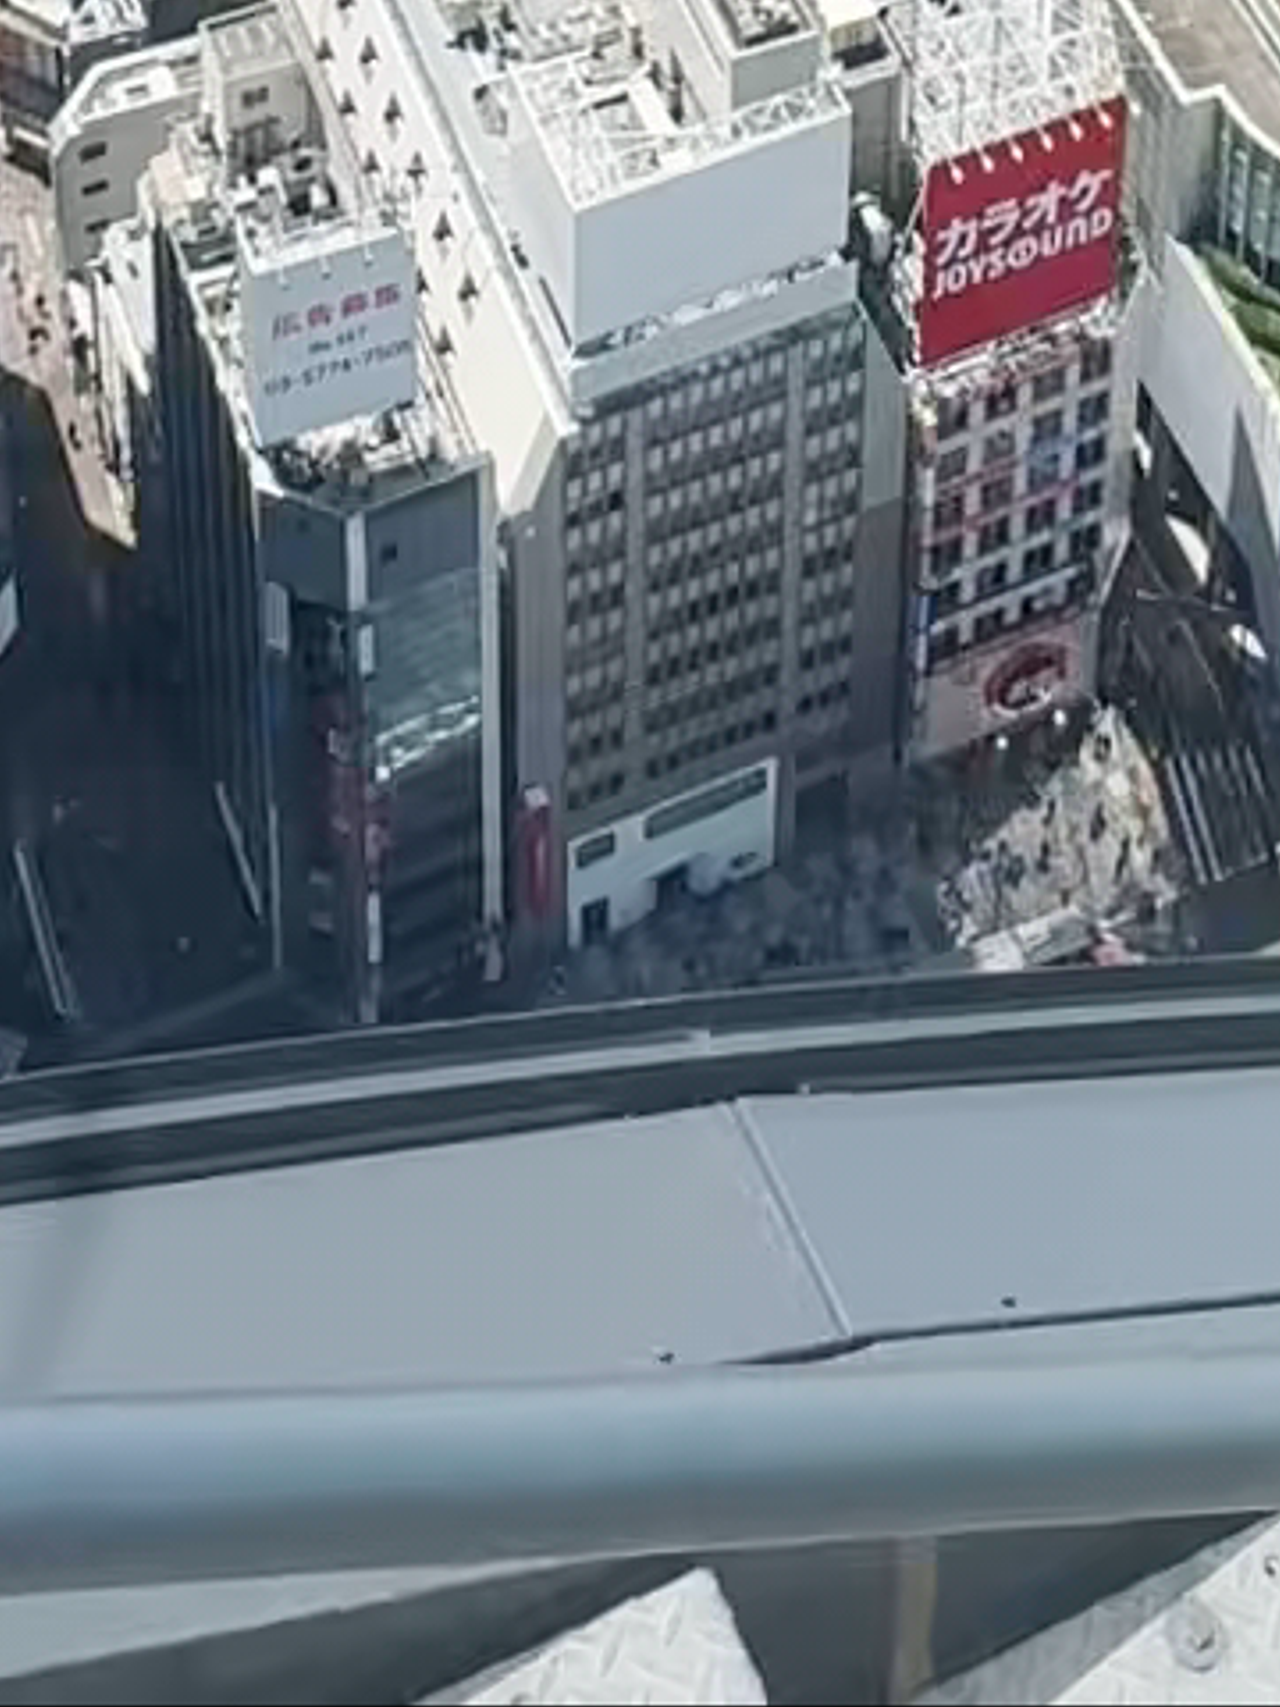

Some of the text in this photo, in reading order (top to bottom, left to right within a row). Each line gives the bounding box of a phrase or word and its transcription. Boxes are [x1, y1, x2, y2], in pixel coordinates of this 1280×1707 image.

[932, 207, 1114, 301] JOYSOUND
[935, 168, 1114, 267] カラオケ
